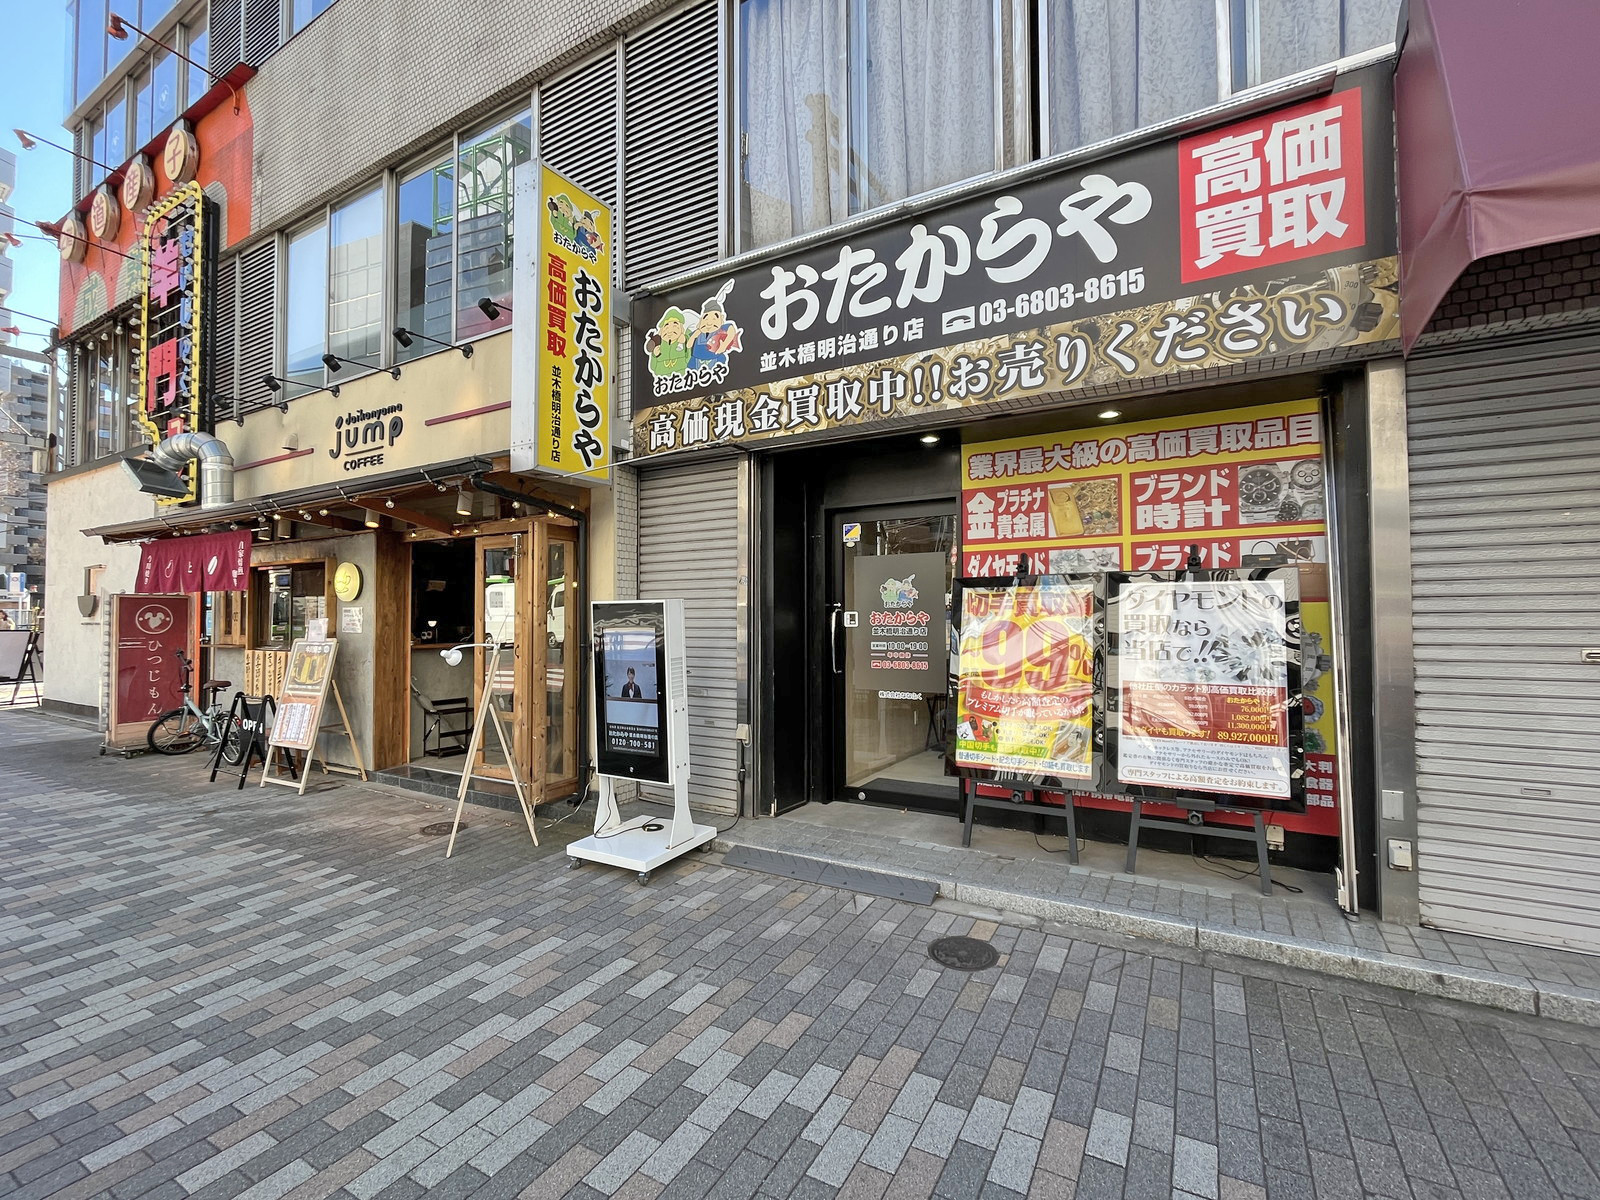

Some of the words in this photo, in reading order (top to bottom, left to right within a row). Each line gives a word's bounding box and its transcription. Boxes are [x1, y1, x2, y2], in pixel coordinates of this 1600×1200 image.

[1192, 105, 1342, 205] 高価
[1194, 177, 1349, 269] 買取
[554, 231, 598, 265] おたからや
[760, 174, 1152, 340] おたからや
[547, 253, 567, 359] 高価買取
[979, 267, 1145, 325] 03-6803-8615
[760, 318, 924, 372] 並木橋明治通り店
[572, 270, 602, 468] おたからや
[654, 364, 729, 396] おたからや
[345, 403, 402, 425] daikanyama
[551, 365, 561, 463] 並木橋明治通り店
[329, 416, 403, 458] jump
[969, 413, 1320, 480] 業界最大級の高価買取品目
[344, 453, 384, 471] COFFEE
[998, 488, 1045, 512] プラチナ
[1135, 466, 1230, 503] ブランド
[966, 491, 995, 540] 金
[997, 512, 1045, 539] 貴金属
[1136, 498, 1231, 530] 時計
[968, 592, 1094, 617] 切手買取
[1125, 589, 1284, 612] ダイヤモンドの
[870, 611, 930, 626] おたからや
[872, 627, 928, 636] 並木橋明治通り店
[1123, 614, 1211, 637] 買取なら
[982, 620, 1092, 690] 99%
[147, 639, 163, 715] ひつじもん
[612, 738, 655, 749] 0120-700-581
[1217, 732, 1279, 745] 89,927,000円
[1306, 777, 1334, 791] 食器
[1306, 793, 1335, 808] 部品
